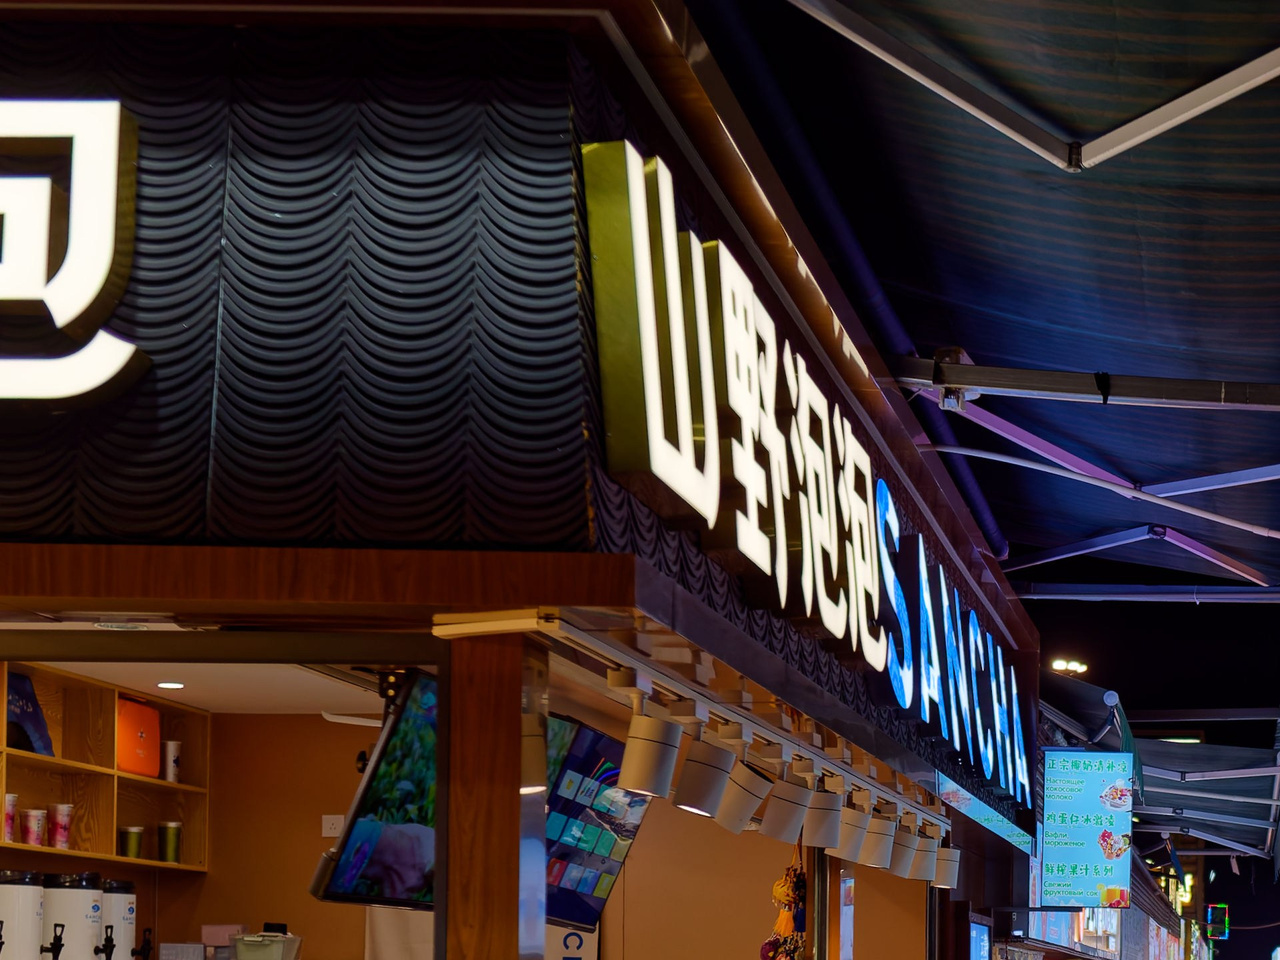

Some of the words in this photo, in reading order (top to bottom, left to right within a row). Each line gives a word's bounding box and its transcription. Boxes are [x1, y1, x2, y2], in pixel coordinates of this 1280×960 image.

[625, 140, 887, 672] 山野泡泡
[876, 478, 1032, 809] SANCHA
